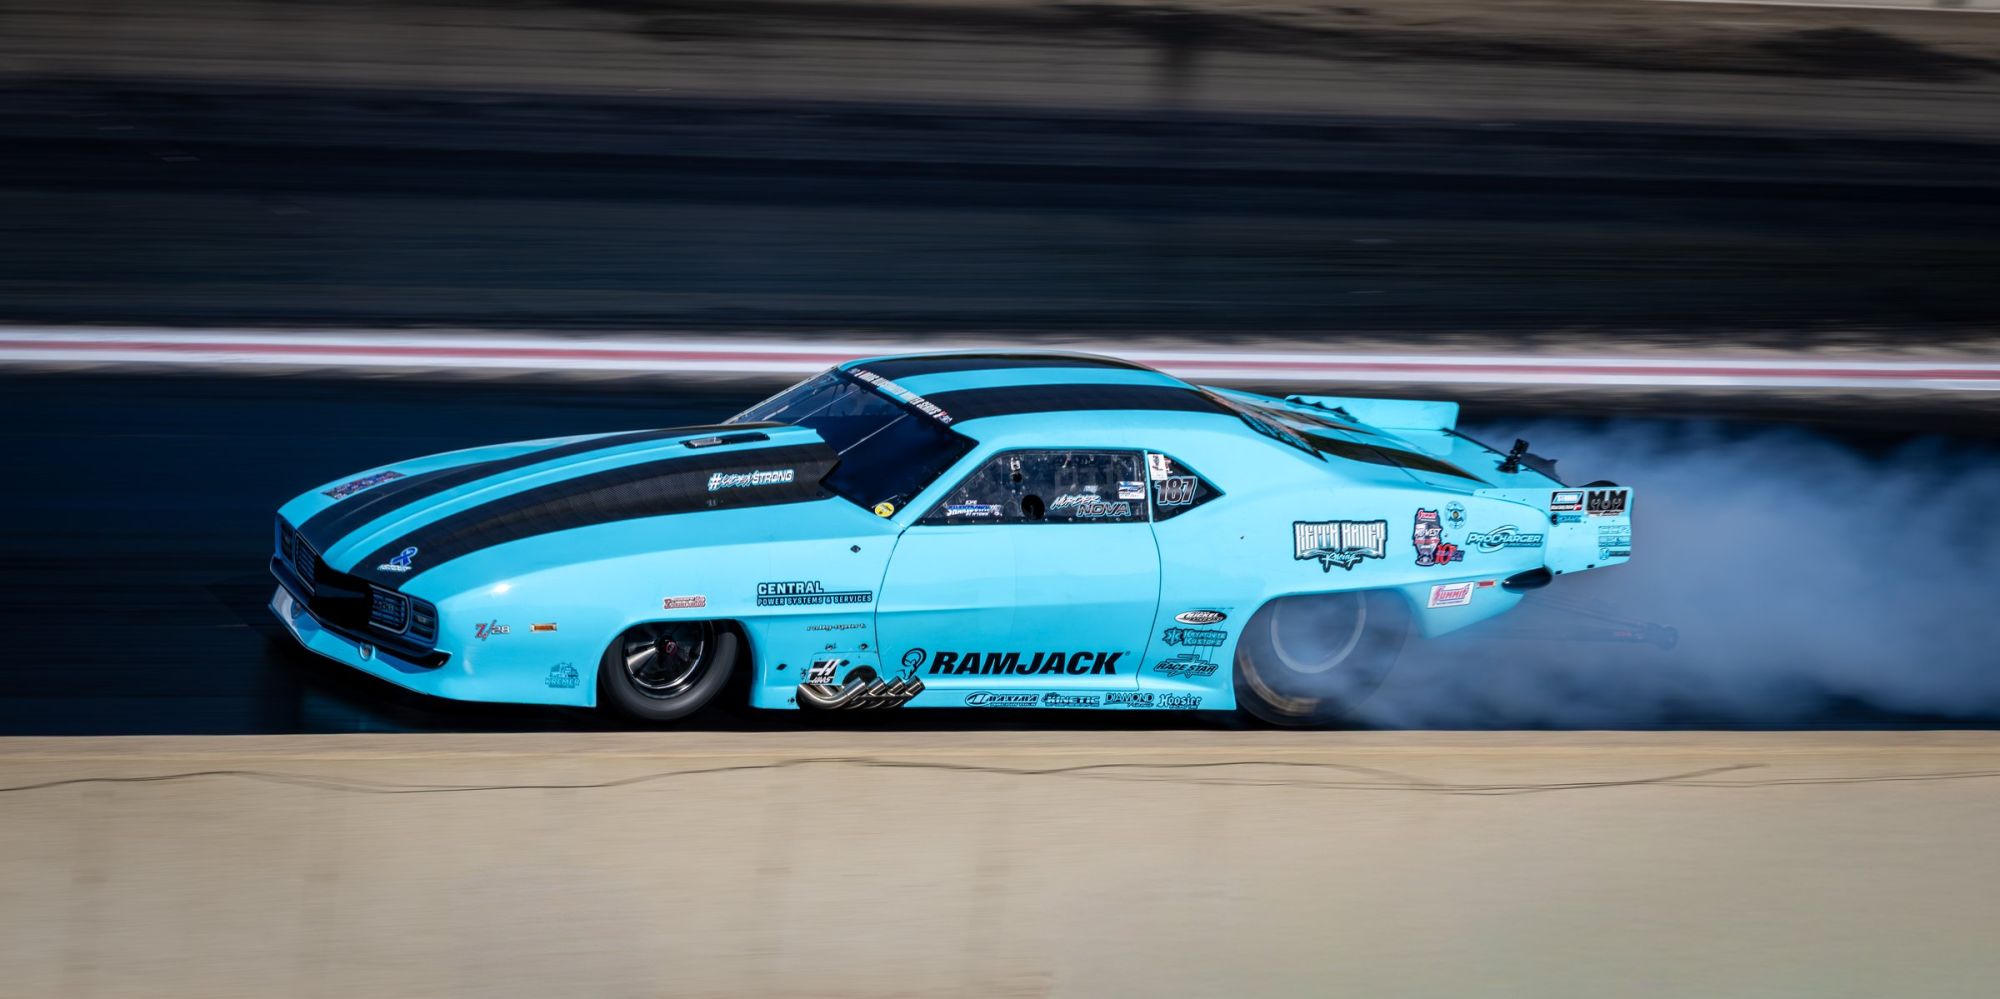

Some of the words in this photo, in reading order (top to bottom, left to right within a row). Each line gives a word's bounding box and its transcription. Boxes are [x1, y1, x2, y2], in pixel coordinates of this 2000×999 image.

[1156, 477, 1197, 505] 187
[1077, 501, 1131, 517] NOVA
[1295, 522, 1339, 558] KEITH
[1341, 521, 1386, 558] HANEY
[758, 582, 823, 595] CENTRAL
[758, 597, 785, 606] POWER
[787, 596, 824, 605] SYSTEMS
[834, 595, 872, 603] SERVICES
[929, 651, 1124, 675] RAMJACK
[1157, 661, 1187, 671] RACE
[1189, 664, 1216, 673] STAR
[1045, 694, 1100, 705] KINETIC
[1106, 692, 1154, 704] DIAMOND
